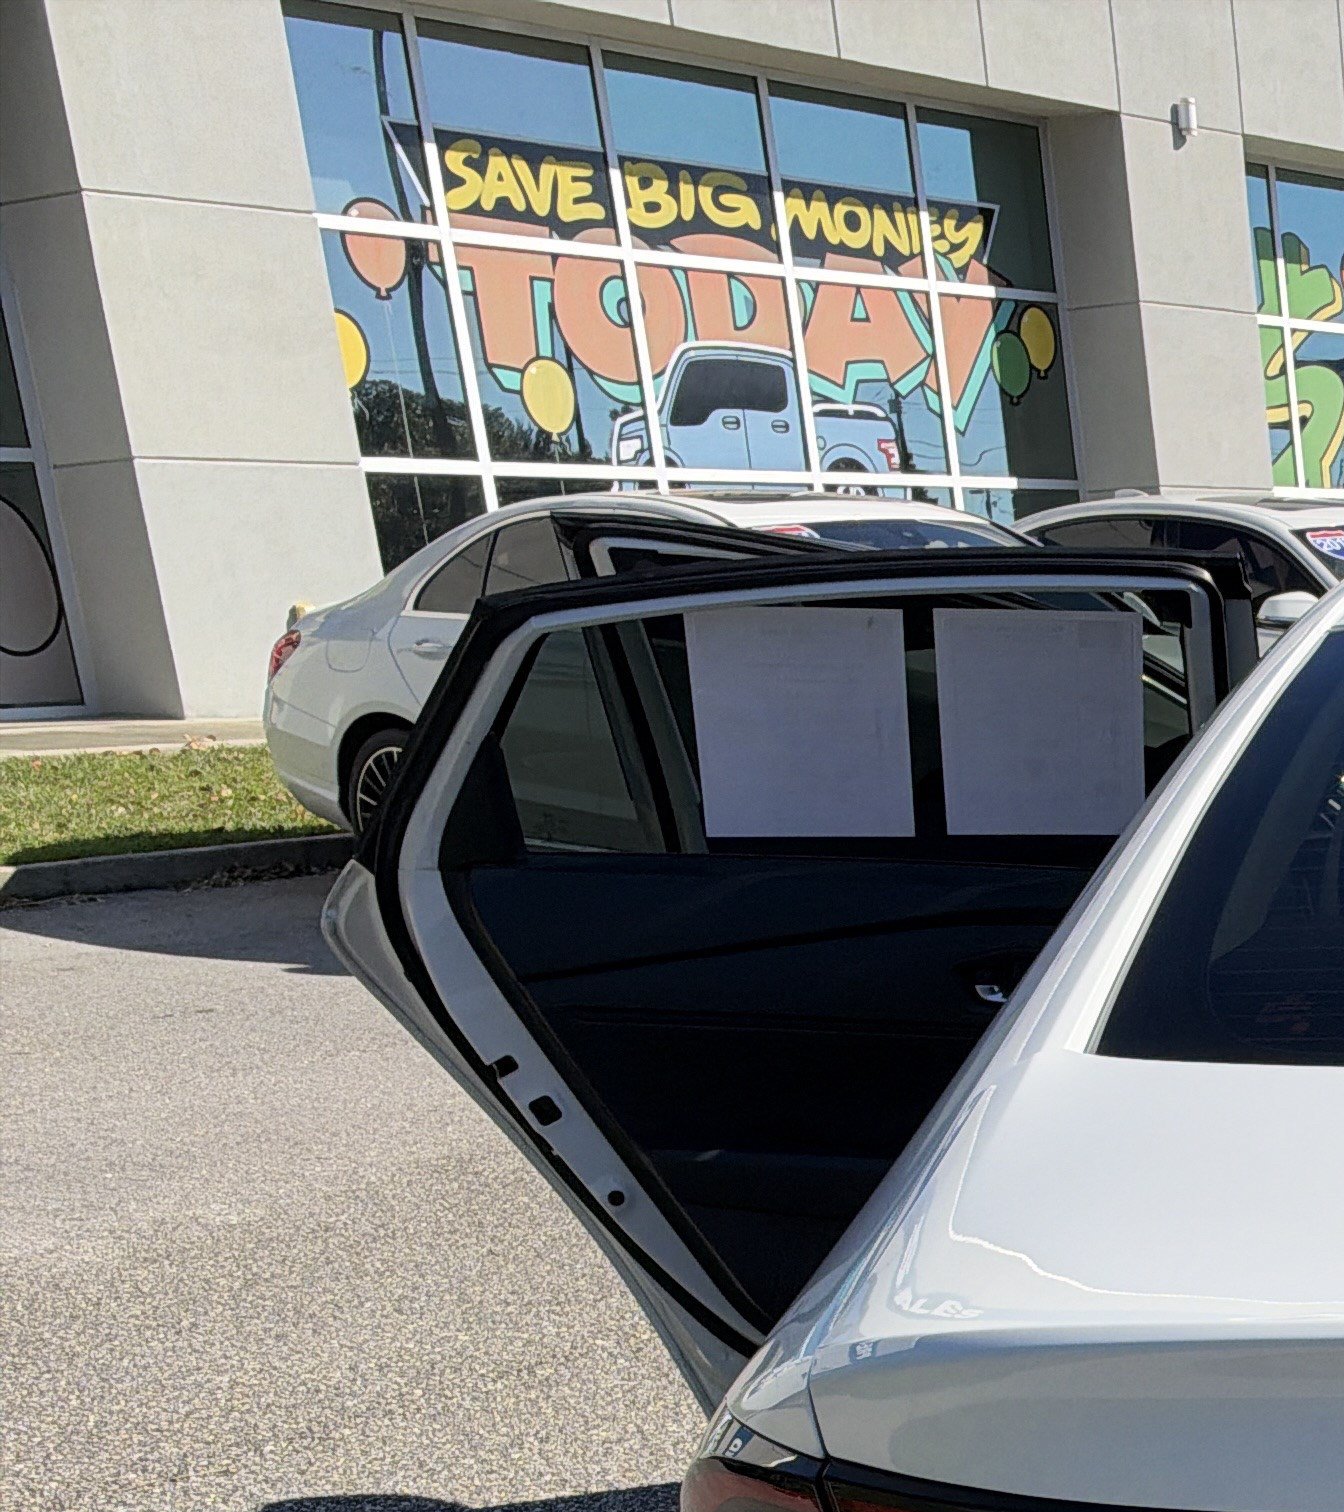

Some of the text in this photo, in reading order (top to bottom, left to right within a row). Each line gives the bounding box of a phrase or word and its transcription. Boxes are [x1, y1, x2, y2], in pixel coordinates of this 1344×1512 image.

[444, 138, 985, 268] SAVE BIG MONEY
[426, 209, 1006, 424] TODAY
